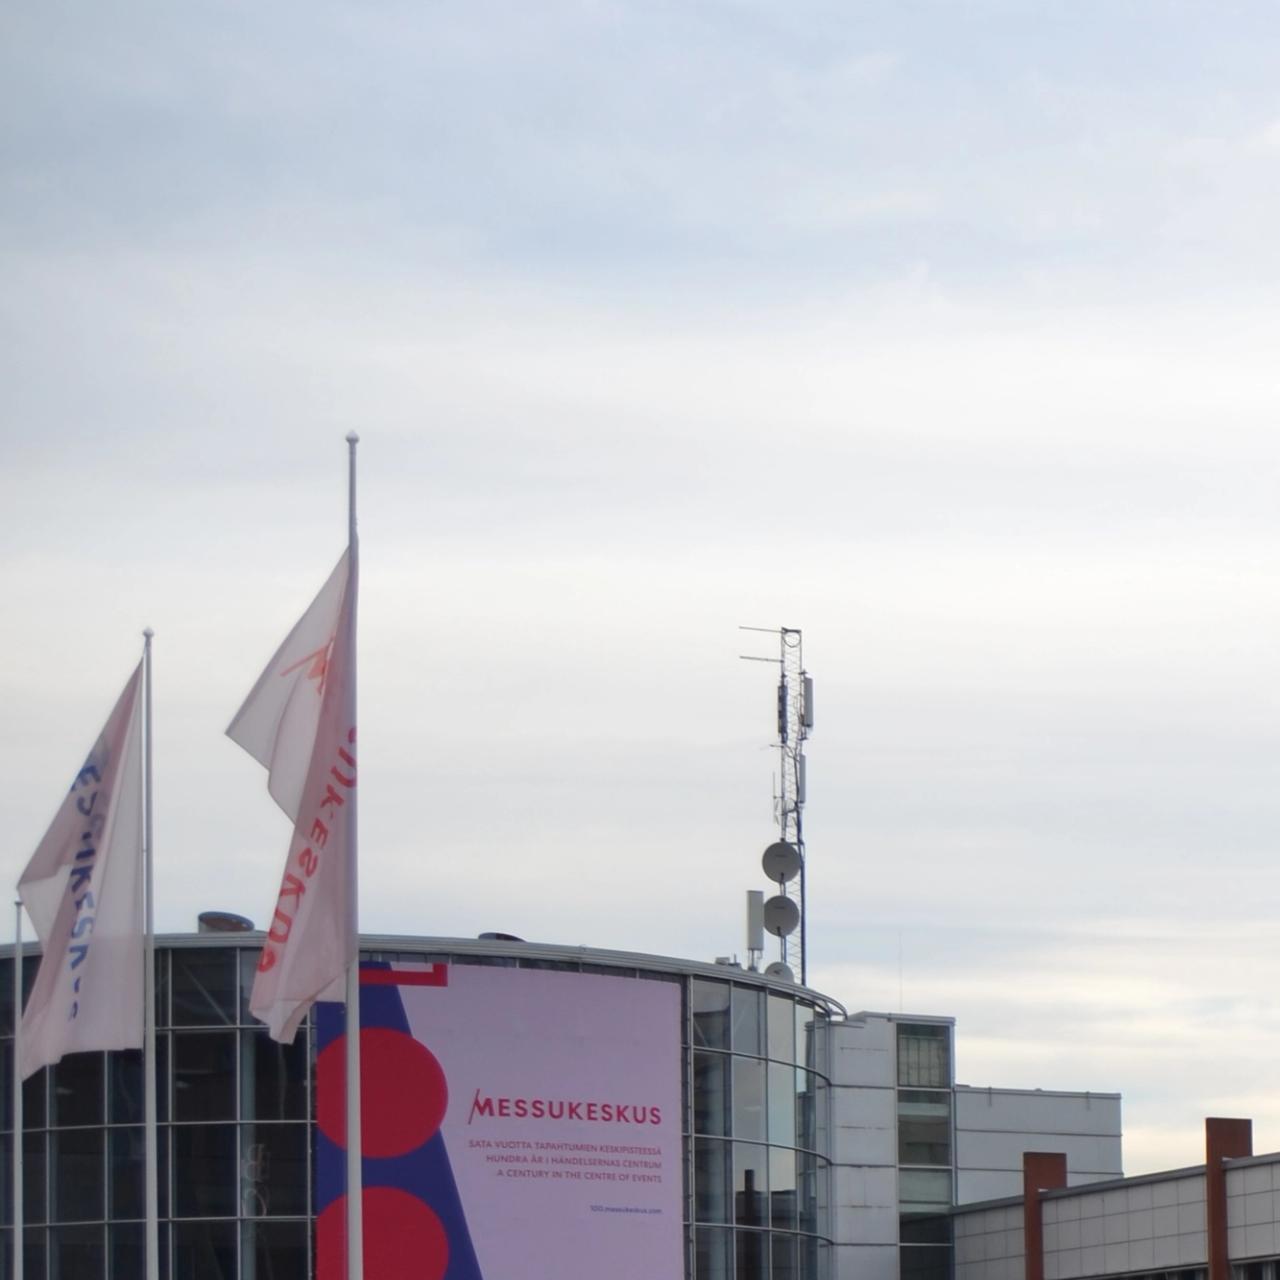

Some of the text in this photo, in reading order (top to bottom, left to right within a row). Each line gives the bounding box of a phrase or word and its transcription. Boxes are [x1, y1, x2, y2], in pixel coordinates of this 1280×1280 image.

[467, 1088, 662, 1126] MESSUKESKUS
[468, 1139, 493, 1149] SATA
[495, 1140, 532, 1150] VUOTTA
[534, 1142, 597, 1153] TAPAHTUMIEN
[486, 1154, 528, 1164] HUNDRA
[530, 1152, 543, 1164] ÅR
[622, 1160, 662, 1170] CENTRUM
[496, 1168, 662, 1184] A CENTURY IN THE CENTRE OF EVENTS
